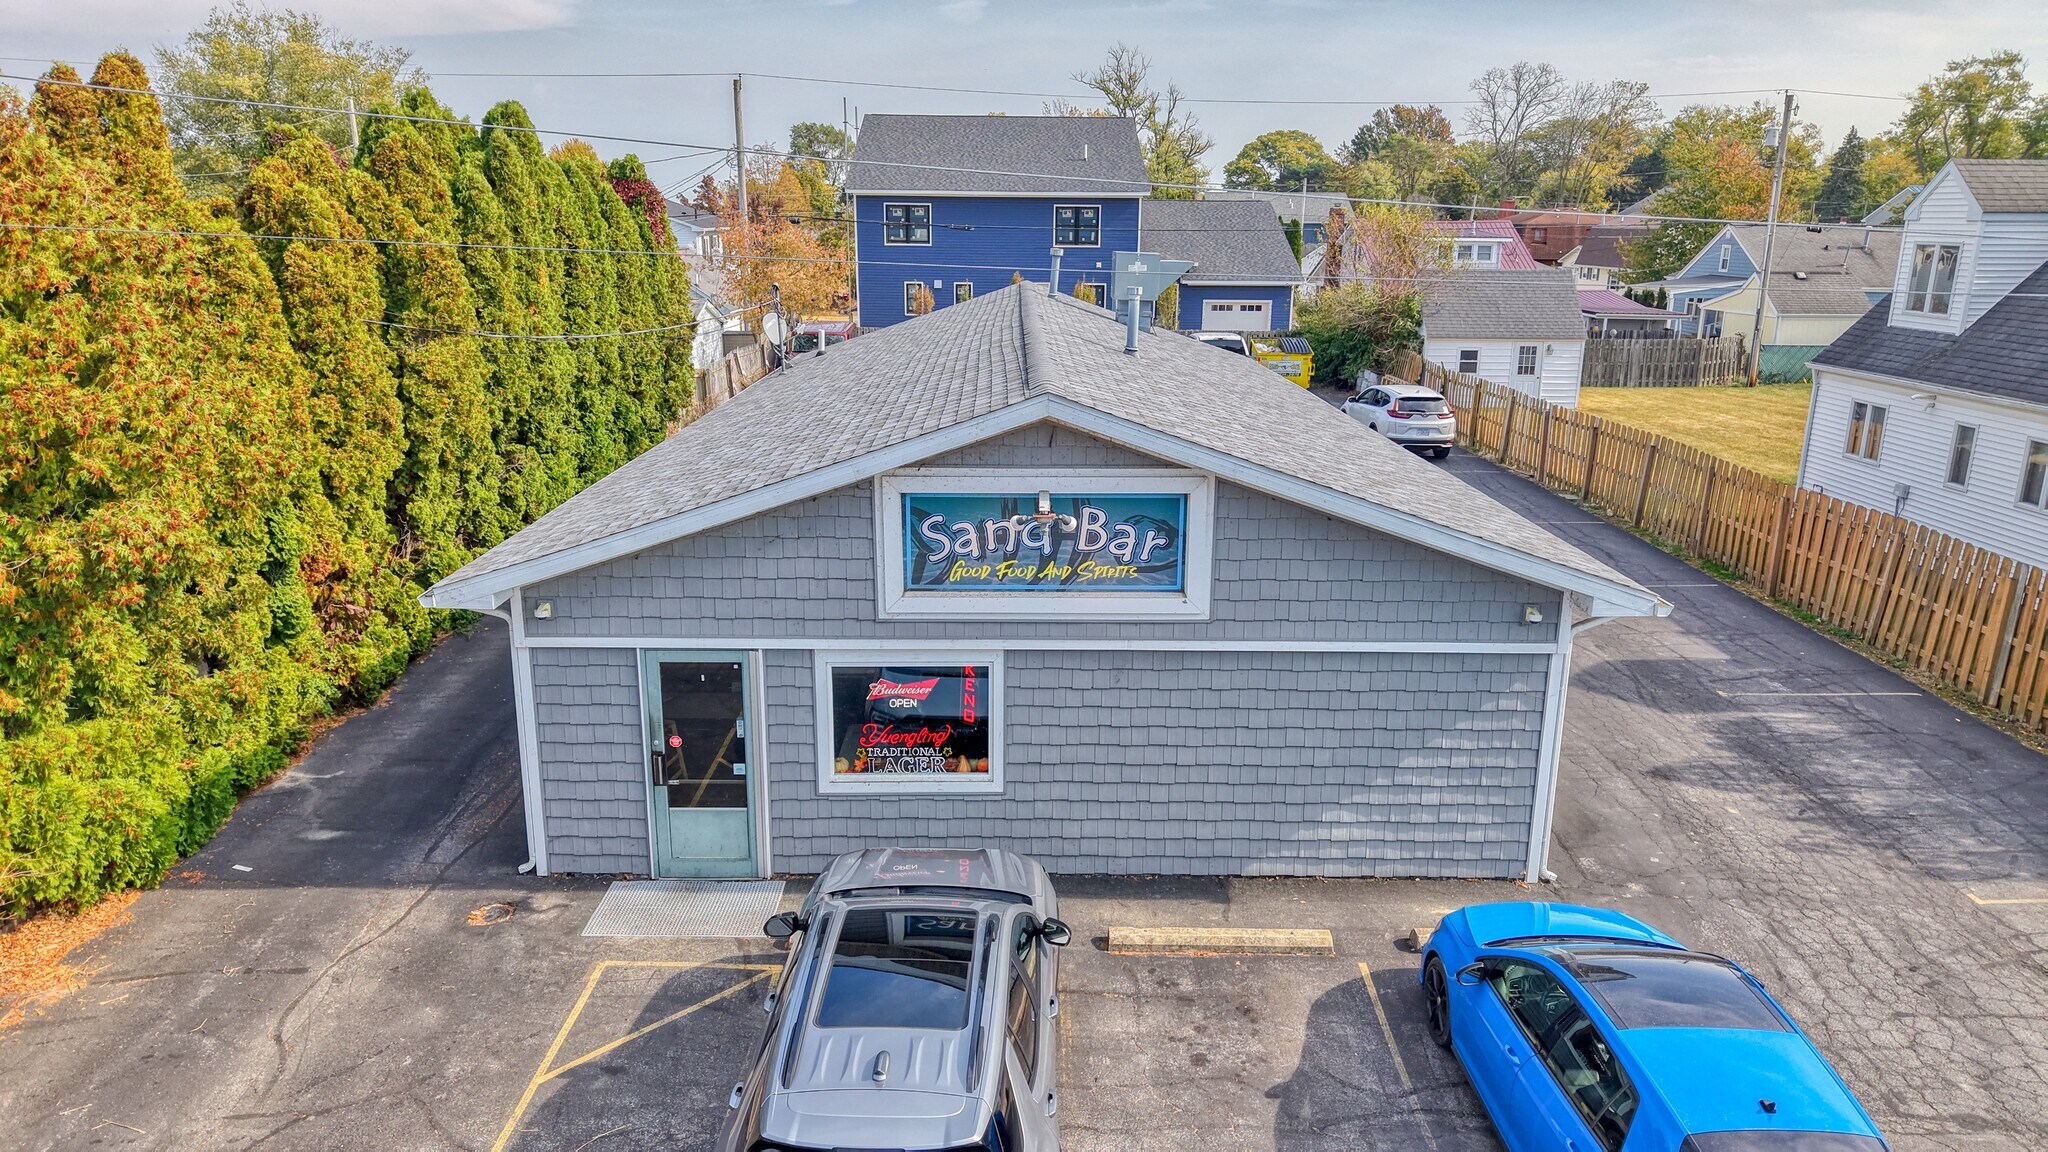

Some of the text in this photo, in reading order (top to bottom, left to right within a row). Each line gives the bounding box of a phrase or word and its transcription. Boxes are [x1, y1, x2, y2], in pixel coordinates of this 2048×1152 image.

[1075, 504, 1169, 564] Bar
[868, 682, 932, 697] Budweiser
[963, 664, 976, 723] KENO
[889, 698, 917, 708] OPEN
[859, 723, 952, 748] Yuengling
[866, 747, 943, 757] TRADITIONAL
[867, 756, 946, 774] LAGER
